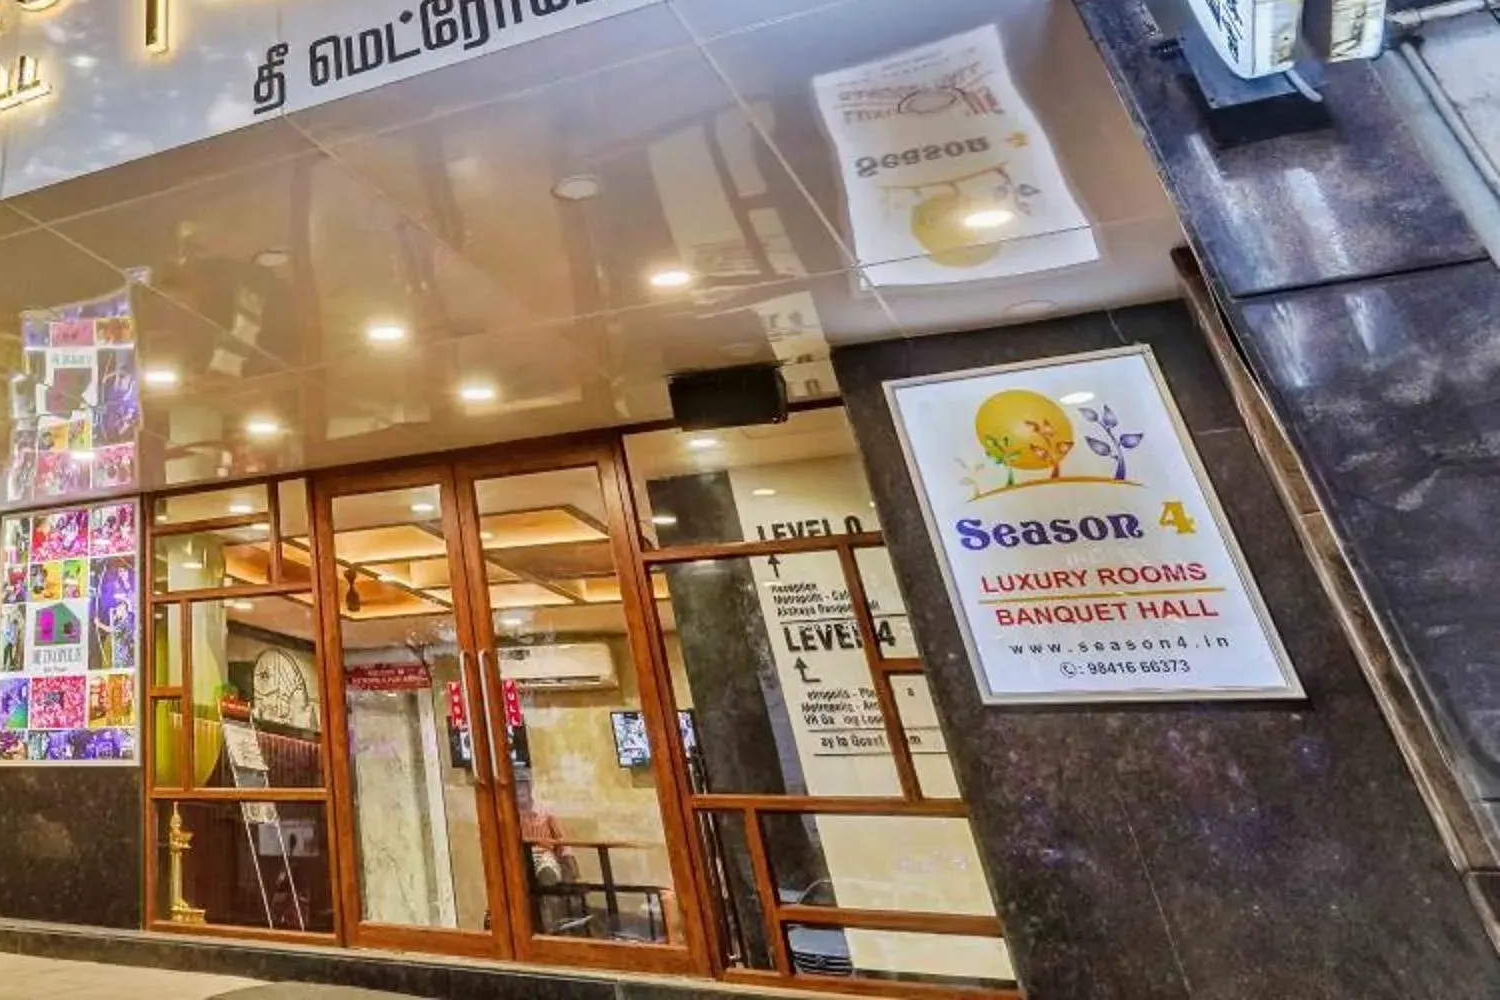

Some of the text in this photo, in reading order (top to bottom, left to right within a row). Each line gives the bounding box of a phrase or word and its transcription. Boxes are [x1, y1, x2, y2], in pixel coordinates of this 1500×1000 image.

[253, 42, 289, 115] தீ
[955, 501, 1196, 551] Season 4
[981, 562, 1207, 593] LUXURY ROOMS
[996, 599, 1219, 625] BANQUET HALL
[877, 620, 896, 647] 4
[1009, 635, 1229, 654] www.season4.in
